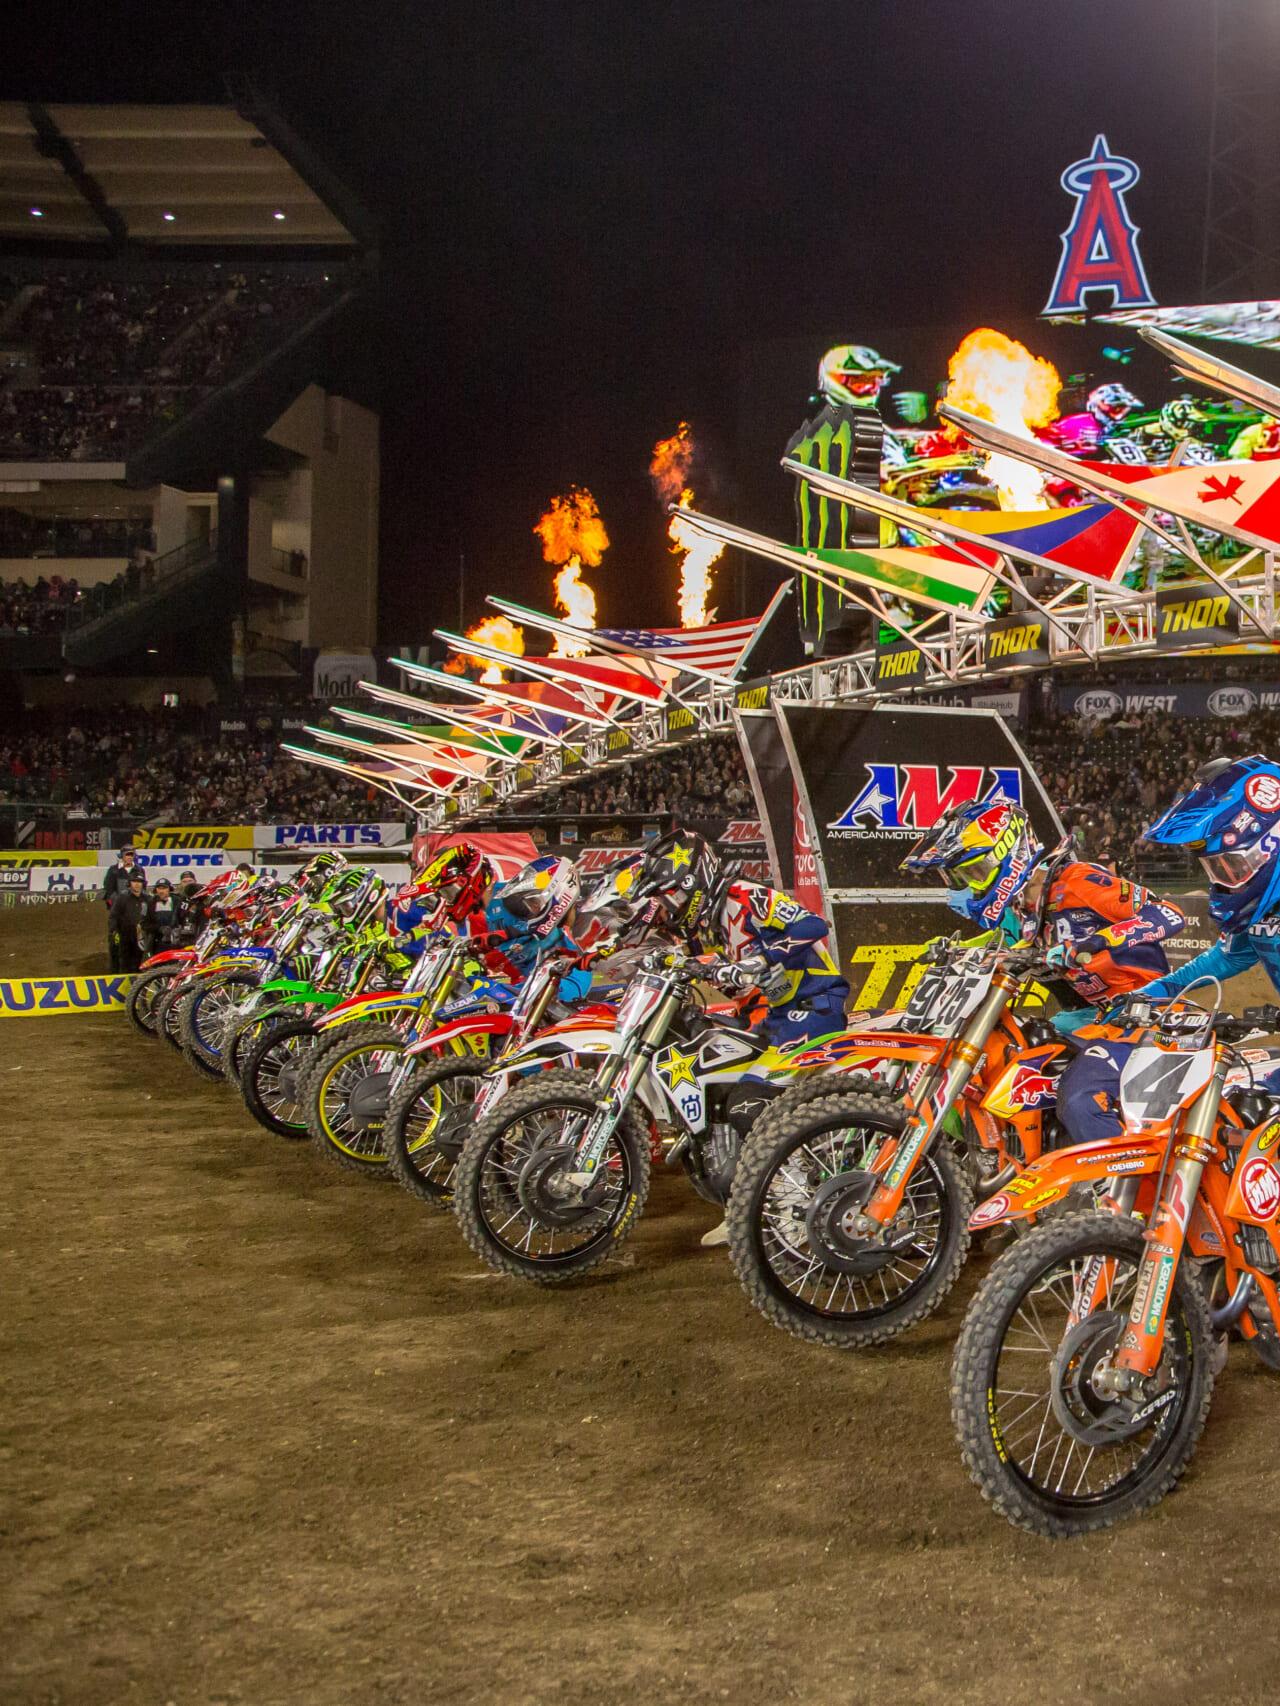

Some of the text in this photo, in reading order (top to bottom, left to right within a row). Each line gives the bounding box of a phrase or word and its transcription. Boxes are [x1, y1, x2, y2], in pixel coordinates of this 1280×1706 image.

[1161, 595, 1231, 633] THOR
[989, 623, 1042, 658] THOR
[879, 649, 921, 679] THOR
[737, 685, 768, 709] THOR
[1085, 695, 1177, 713] FOX WEST
[1218, 692, 1246, 706] FOX
[826, 763, 1023, 829] AMA
[155, 832, 229, 849] THOR
[275, 825, 382, 844] PARTS
[827, 831, 929, 840] AMERICAN MOTOR
[0, 977, 137, 1010] UZUK
[1122, 1053, 1197, 1120] 4
[1076, 1147, 1147, 1164] Palmetto
[1106, 1160, 1145, 1173] LOENBRO
[1080, 1255, 1103, 1319] UNLOP
[1151, 1259, 1172, 1317] MOTOREX
